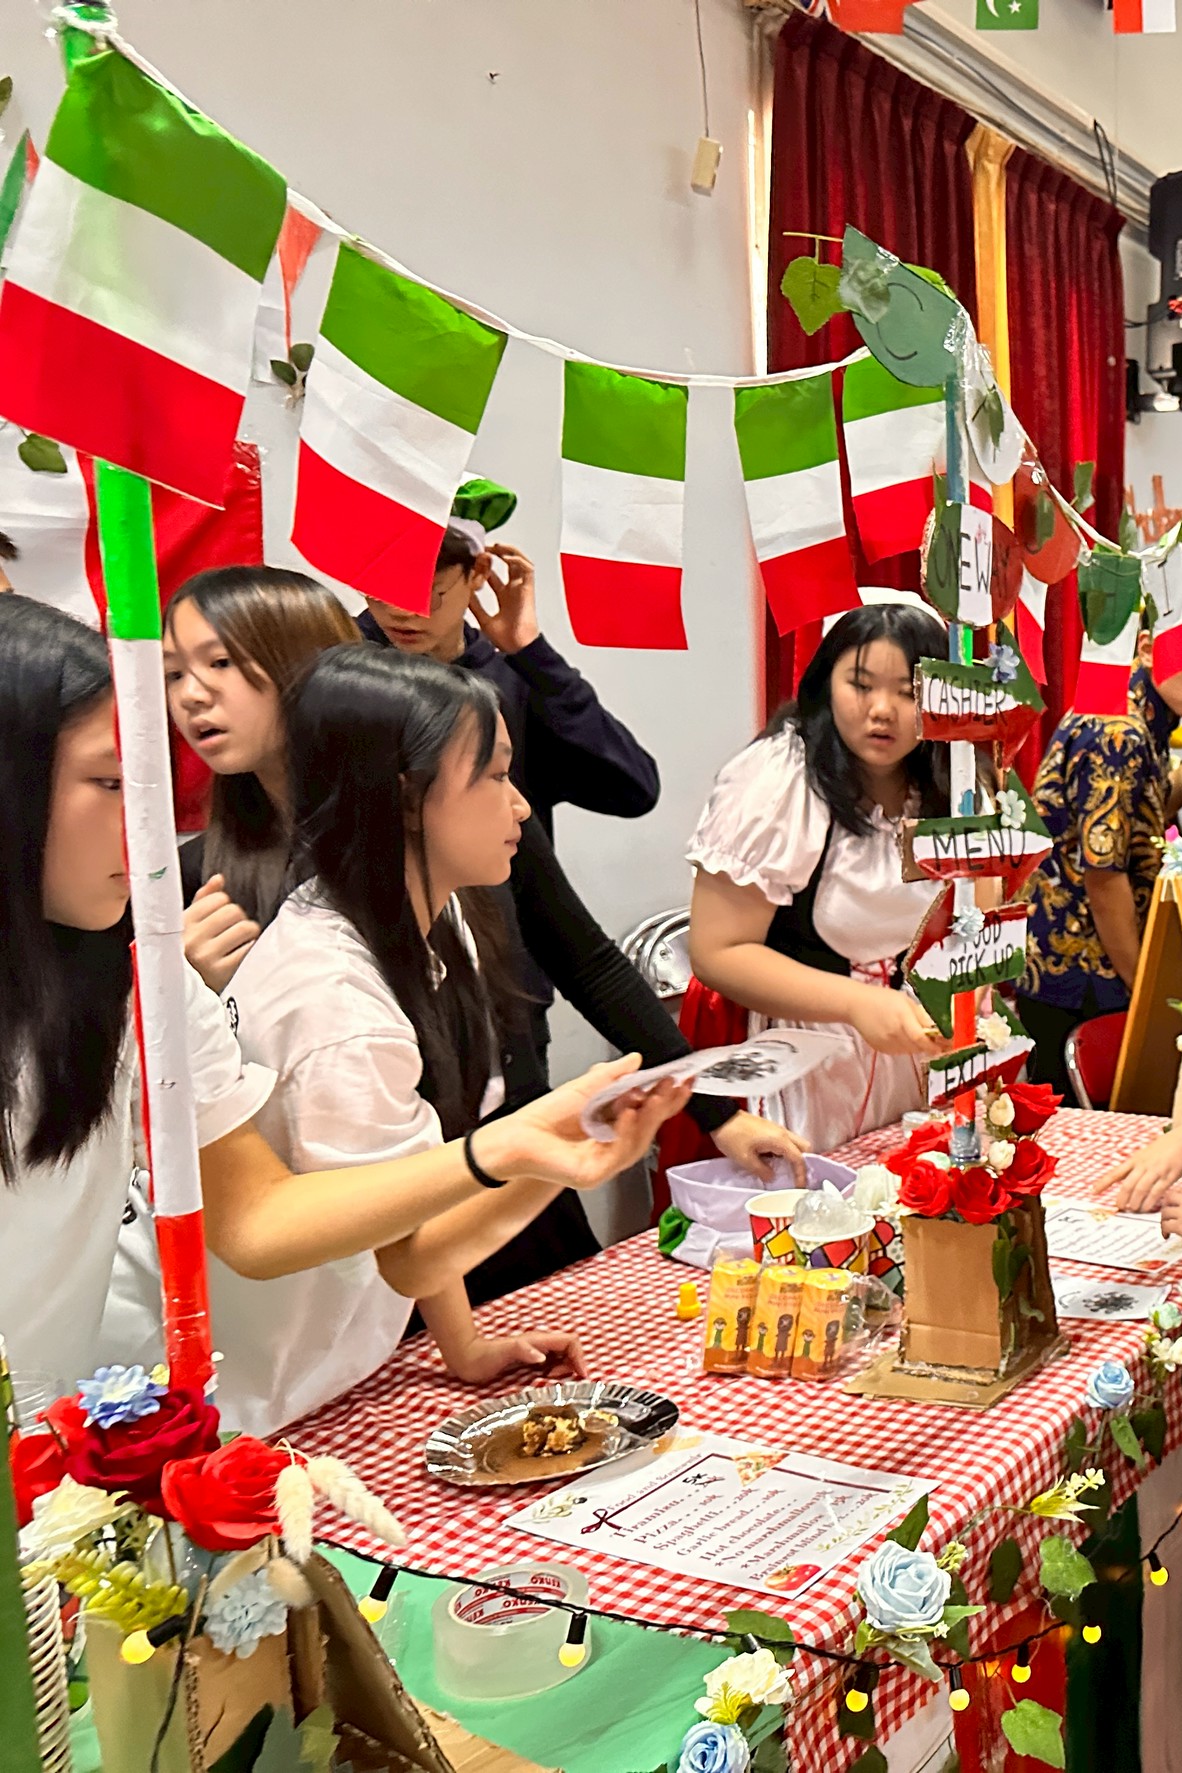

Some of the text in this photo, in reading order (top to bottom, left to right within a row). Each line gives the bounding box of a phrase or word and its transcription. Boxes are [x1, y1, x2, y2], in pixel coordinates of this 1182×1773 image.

[928, 672, 1008, 727] CASHIER
[931, 824, 1027, 872] MENU
[962, 913, 1002, 954] OOD
[950, 942, 1014, 988] PICK UP
[944, 1045, 991, 1099] EXIT
[676, 1532, 716, 1556] Garlic
[699, 1544, 729, 1561] Hot
[794, 1526, 828, 1548] blind
